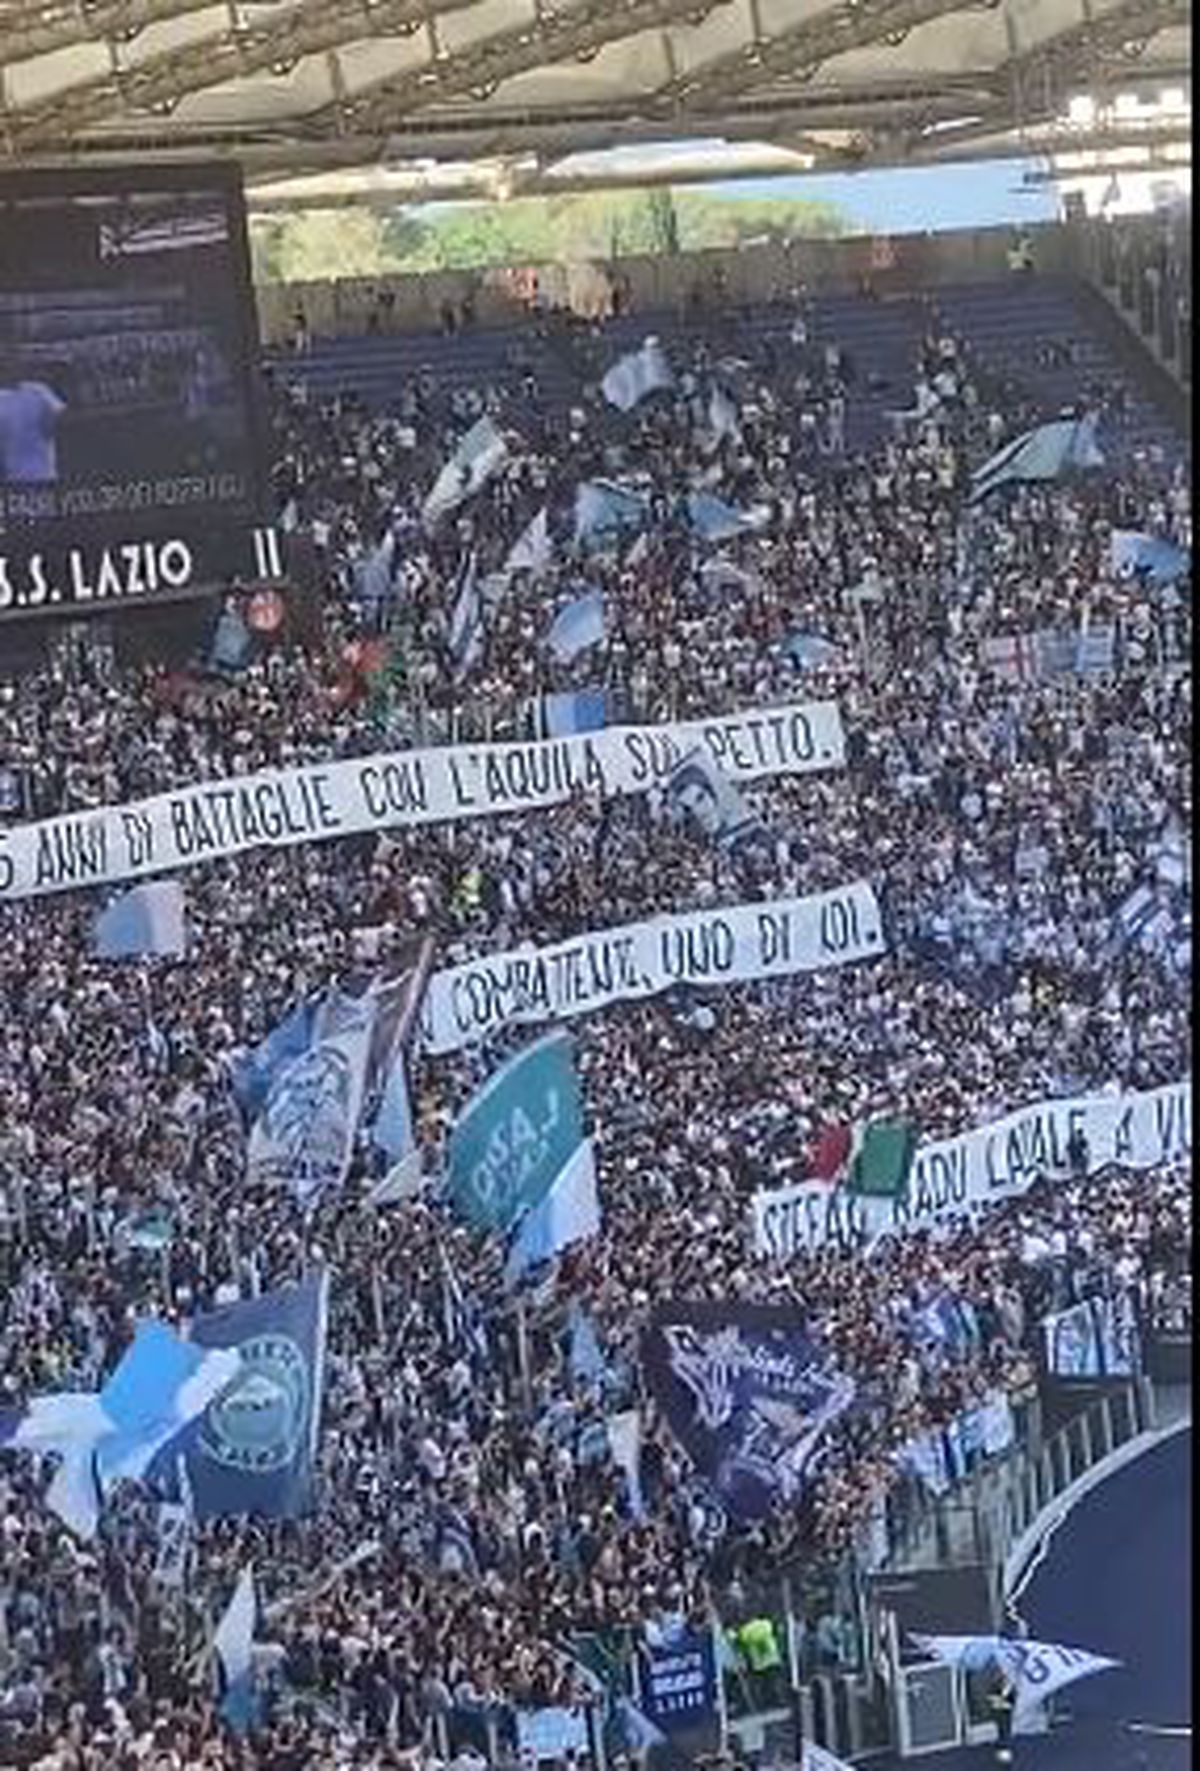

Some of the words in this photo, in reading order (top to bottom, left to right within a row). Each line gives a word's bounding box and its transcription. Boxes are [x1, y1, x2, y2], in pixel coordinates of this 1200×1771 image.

[70, 540, 191, 599] LAZIO
[35, 820, 106, 885] ANNI
[121, 813, 153, 866] DI
[171, 775, 341, 855] BATTAGLIE
[448, 739, 606, 806] L'AQUILA
[704, 713, 832, 771] PETTO.
[661, 917, 735, 979] UNO
[758, 914, 789, 966] DI
